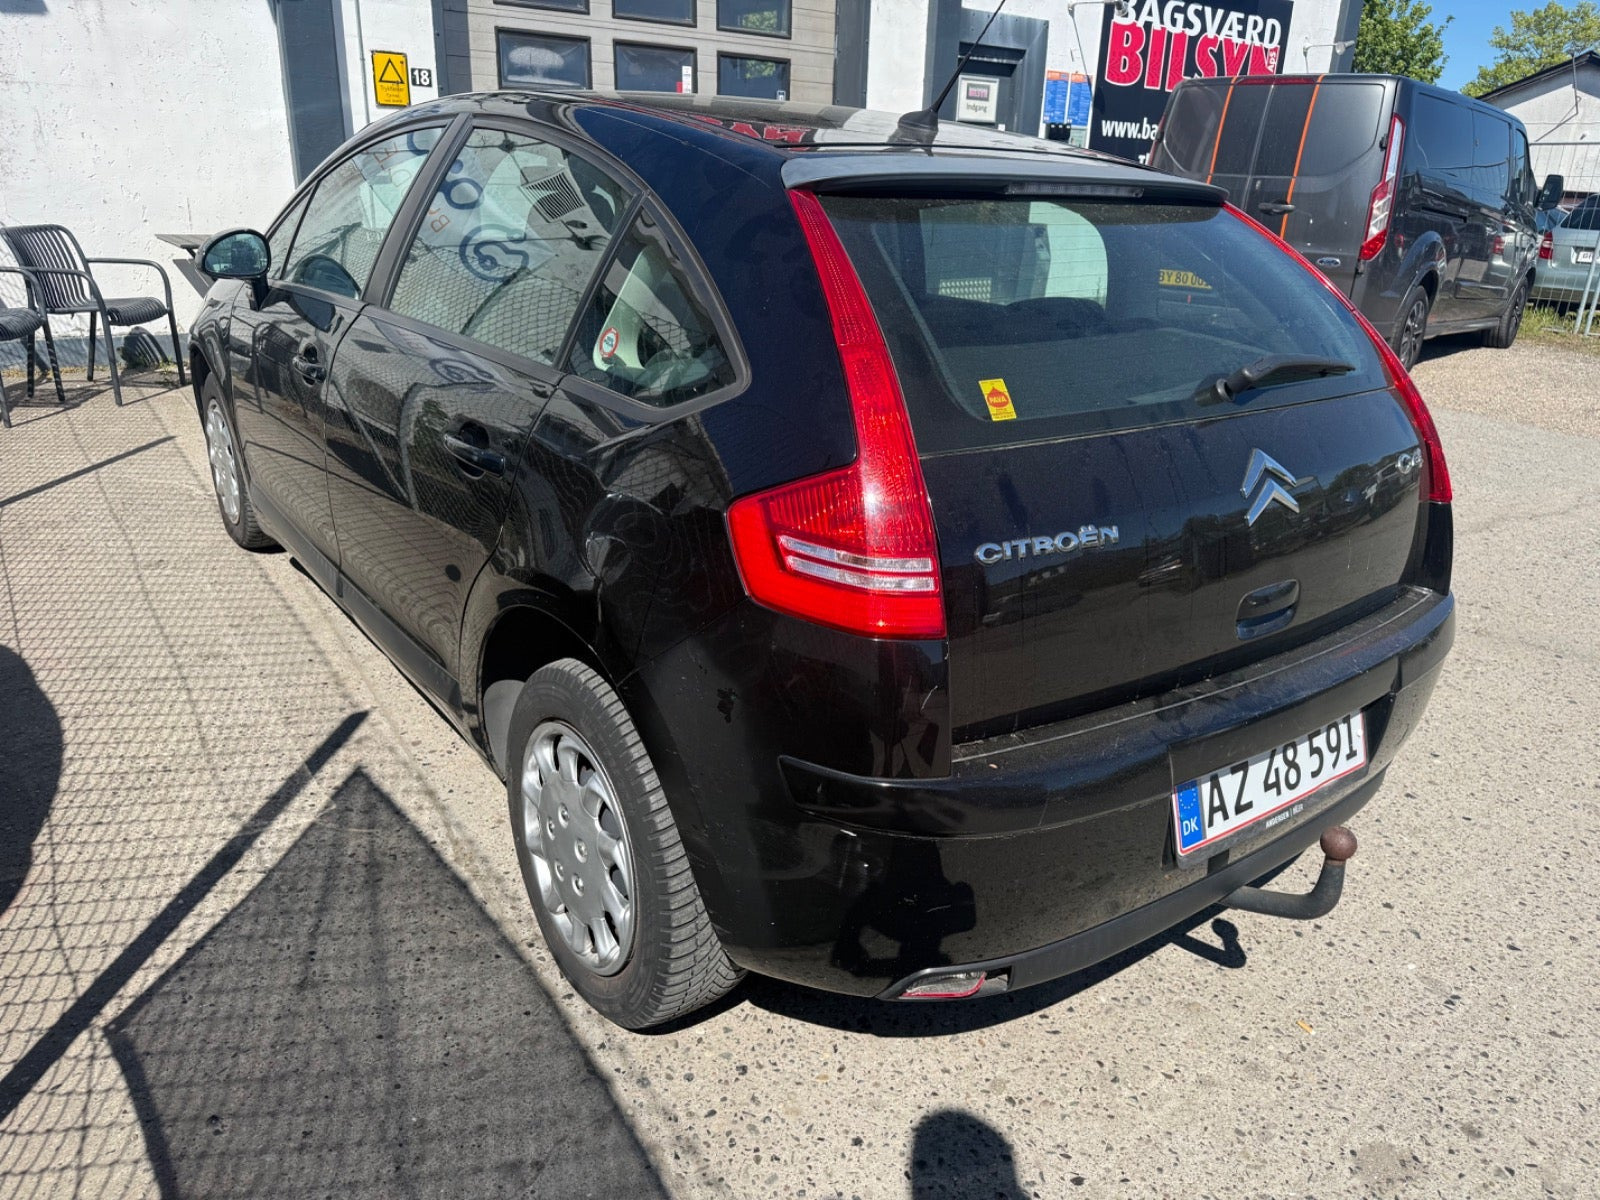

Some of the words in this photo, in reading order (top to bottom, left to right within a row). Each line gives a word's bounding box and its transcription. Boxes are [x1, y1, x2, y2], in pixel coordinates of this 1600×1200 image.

[1113, 0, 1282, 49] BAGSVÆRD
[413, 69, 430, 86] 18
[966, 102, 988, 113] Indgang
[1175, 272, 1189, 284] 80
[974, 524, 1119, 565] CITROËN
[1208, 760, 1253, 829] AZ
[1263, 741, 1301, 797] 48
[1308, 714, 1357, 779] 591
[1183, 816, 1199, 836] DK
